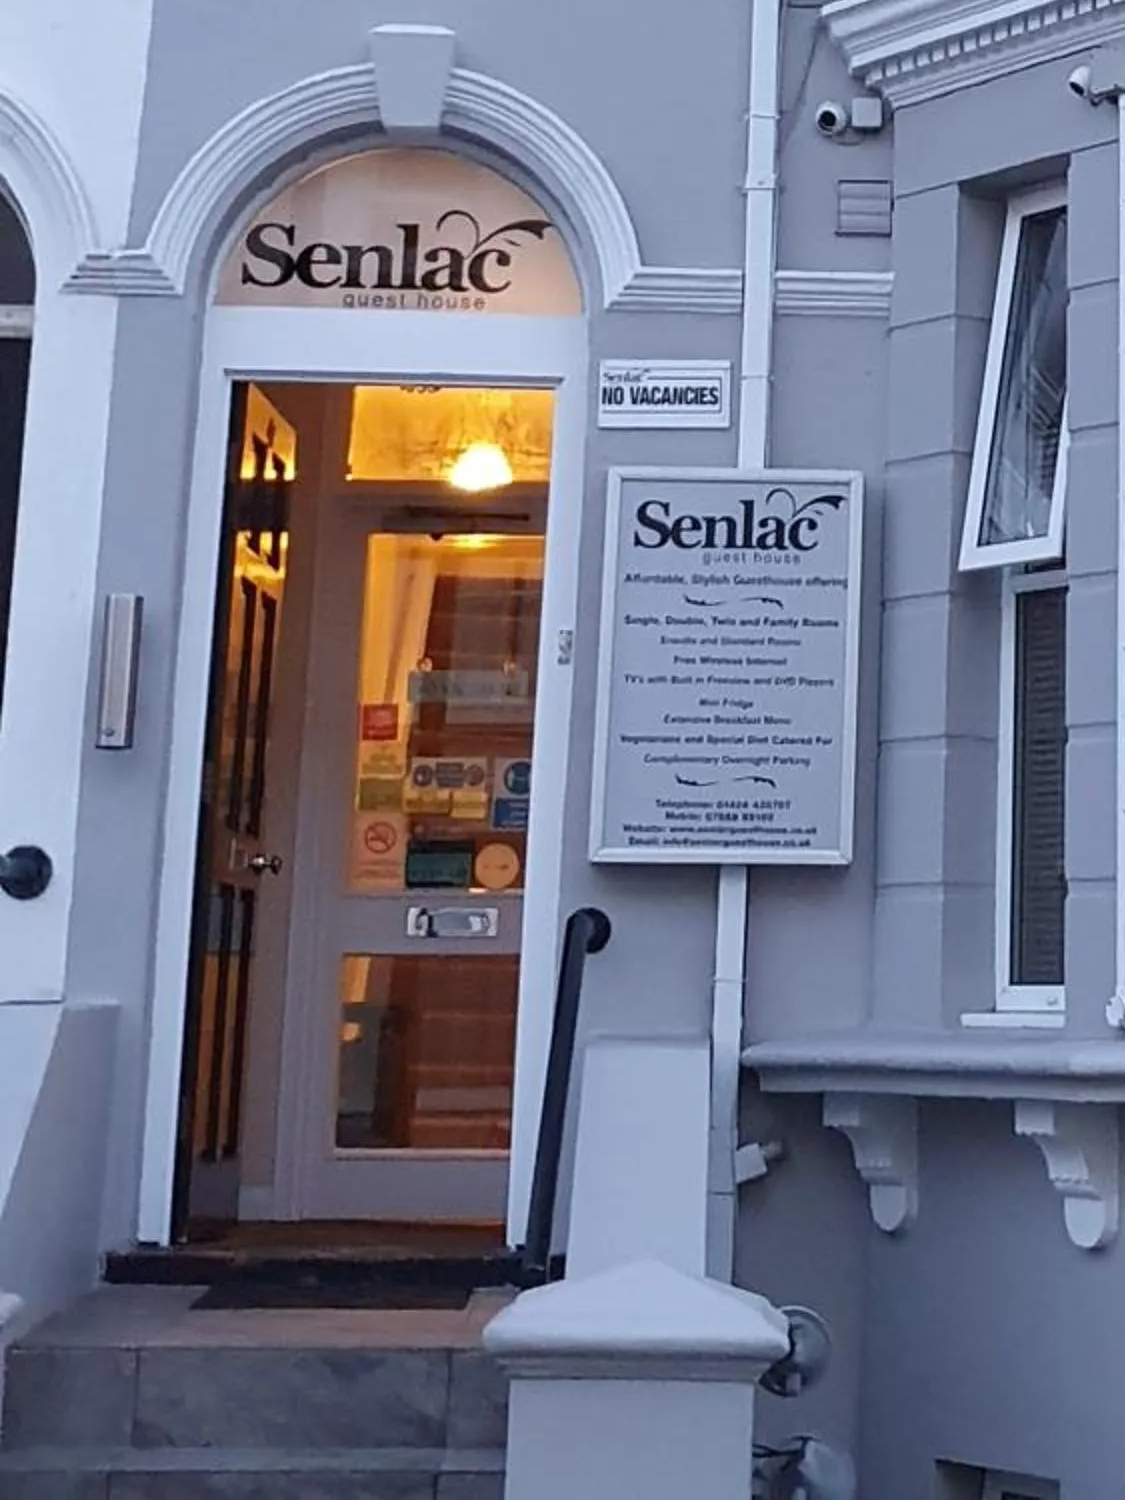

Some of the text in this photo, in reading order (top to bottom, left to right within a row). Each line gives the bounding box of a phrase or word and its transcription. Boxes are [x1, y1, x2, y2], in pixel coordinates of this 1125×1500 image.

[242, 222, 514, 292] Senlac
[343, 293, 486, 311] guest house
[602, 386, 719, 405] NO VACANCIES
[633, 499, 820, 552] Senlac
[703, 551, 801, 566] guest house
[739, 617, 760, 627] and
[763, 616, 799, 628] Family
